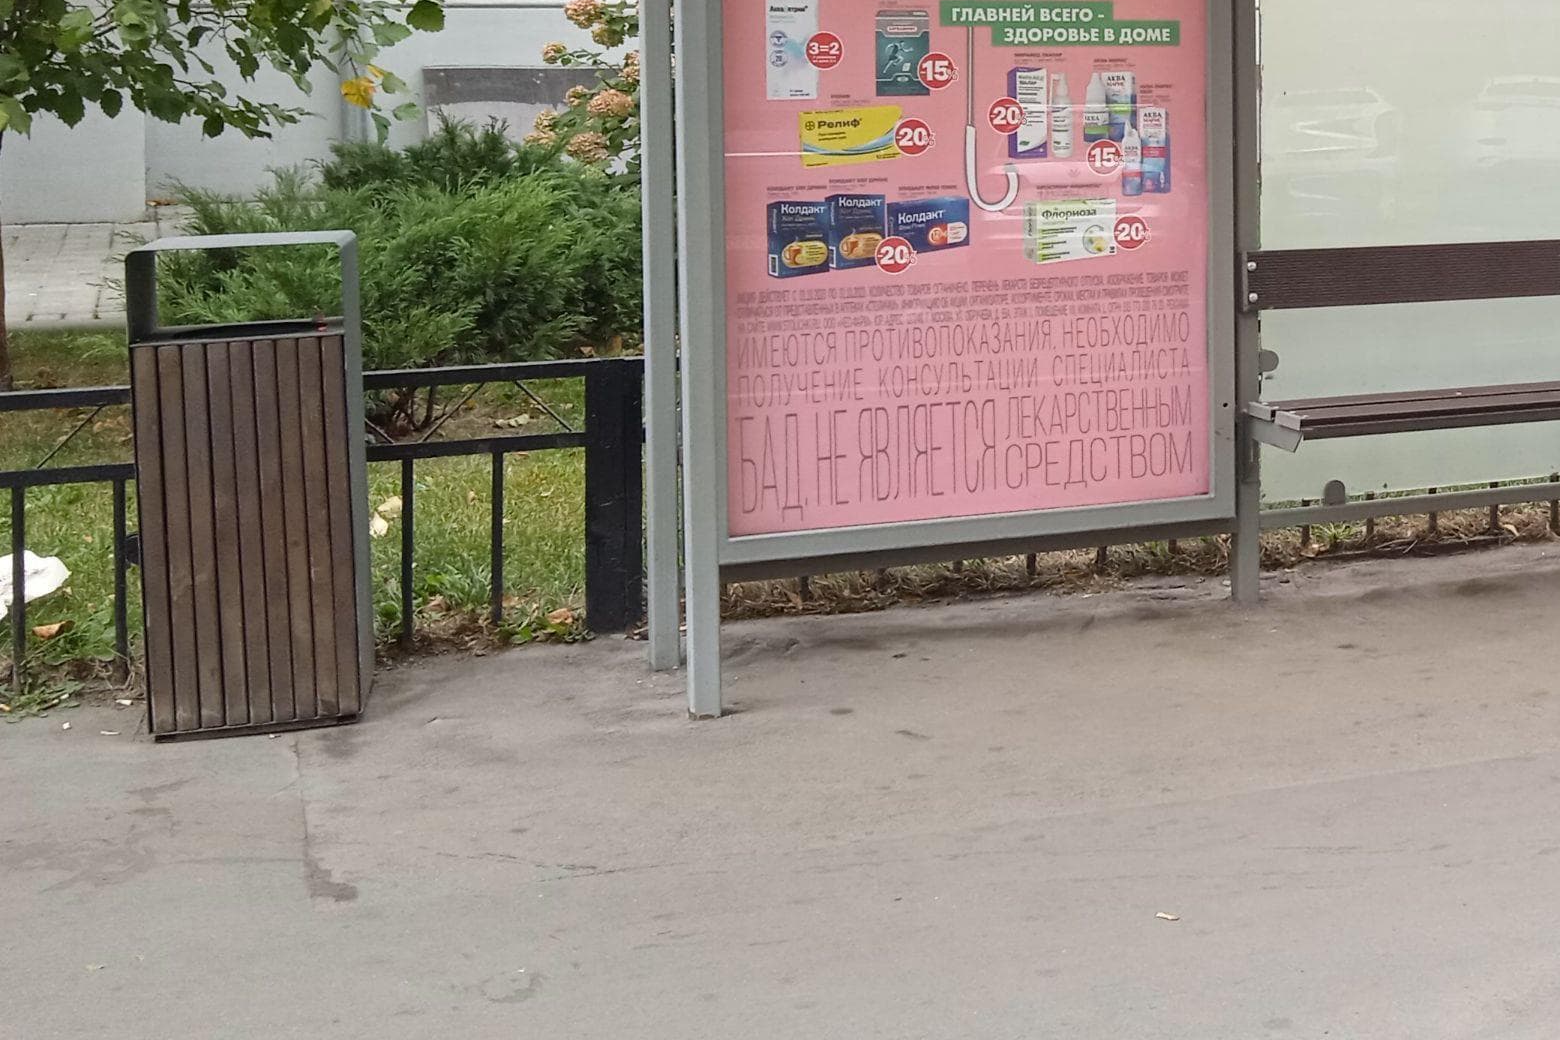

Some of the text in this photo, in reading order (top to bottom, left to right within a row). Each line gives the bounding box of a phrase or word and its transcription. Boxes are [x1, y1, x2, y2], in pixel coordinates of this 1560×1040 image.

[951, 4, 1034, 22] ГЛАВНЕЙ
[1039, 7, 1093, 22] ВСЕГО
[1004, 28, 1170, 44] ЗДОРОВЬЕ В ДОМЕ
[808, 42, 840, 55] 3=2
[817, 118, 860, 129] Релиф
[781, 204, 825, 215] Колдакт
[838, 197, 882, 208] Колдакт
[898, 209, 944, 224] Колдакт
[737, 331, 838, 369] ИМЕЮТСЯ
[1062, 311, 1190, 349] НЕОБХОДИМО
[738, 347, 1191, 408] ПОЛУЧЕНИЕ КОНСУЛЬТАЦИИ СПЕЦИАЛИСТА
[1005, 384, 1192, 440] ЛЕКАРСТВЕННЫМ
[815, 409, 850, 506] НЕ
[858, 398, 997, 503] ЯВЛЯЕТСЯ
[1005, 430, 1193, 490] СРЕДСТВОМ
